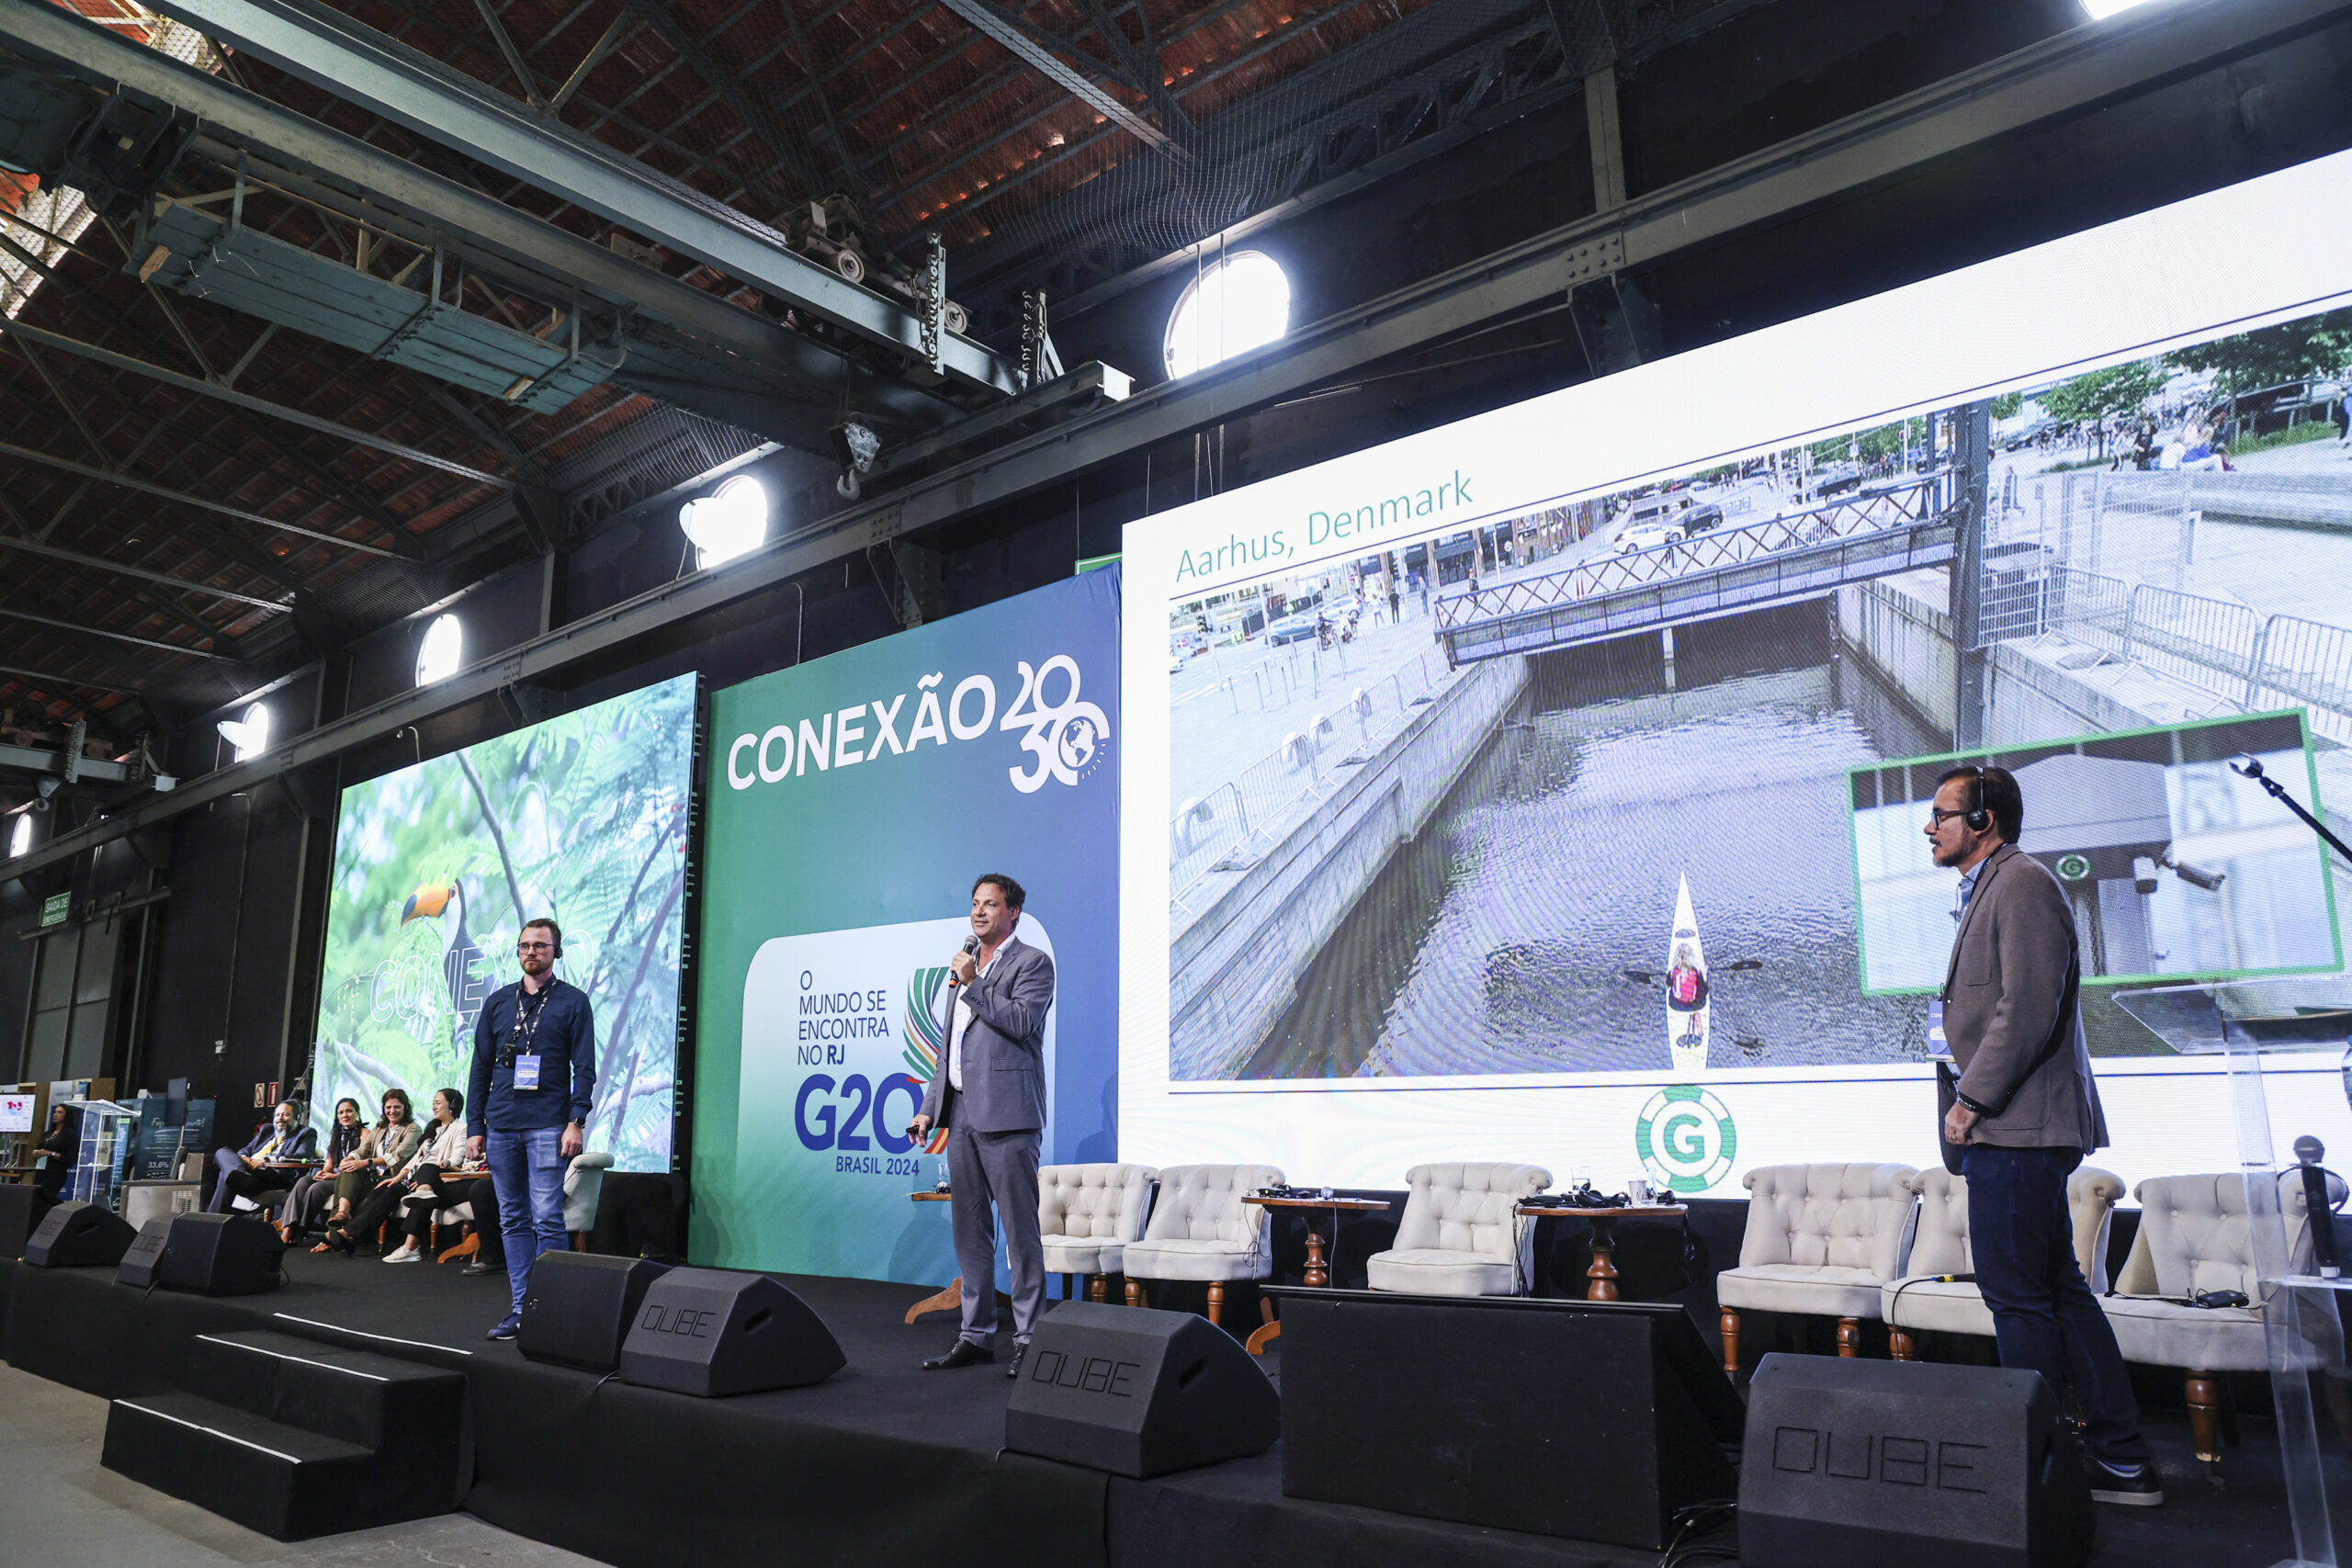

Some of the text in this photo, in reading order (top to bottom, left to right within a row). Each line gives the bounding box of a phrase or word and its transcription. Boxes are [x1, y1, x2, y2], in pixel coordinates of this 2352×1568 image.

[1176, 469, 1473, 582] Aarhus, Denmark
[727, 671, 997, 791] CONEXÃO
[800, 970, 813, 990] O
[799, 990, 887, 1015] MUNDO SE
[798, 1016, 889, 1041] ENCONTRA
[797, 1043, 845, 1066] NO RJ
[795, 1072, 925, 1155] G20
[1663, 1113, 1705, 1164] G
[836, 1156, 920, 1177] BRASIL 2024
[1032, 1350, 1141, 1398] QUBE
